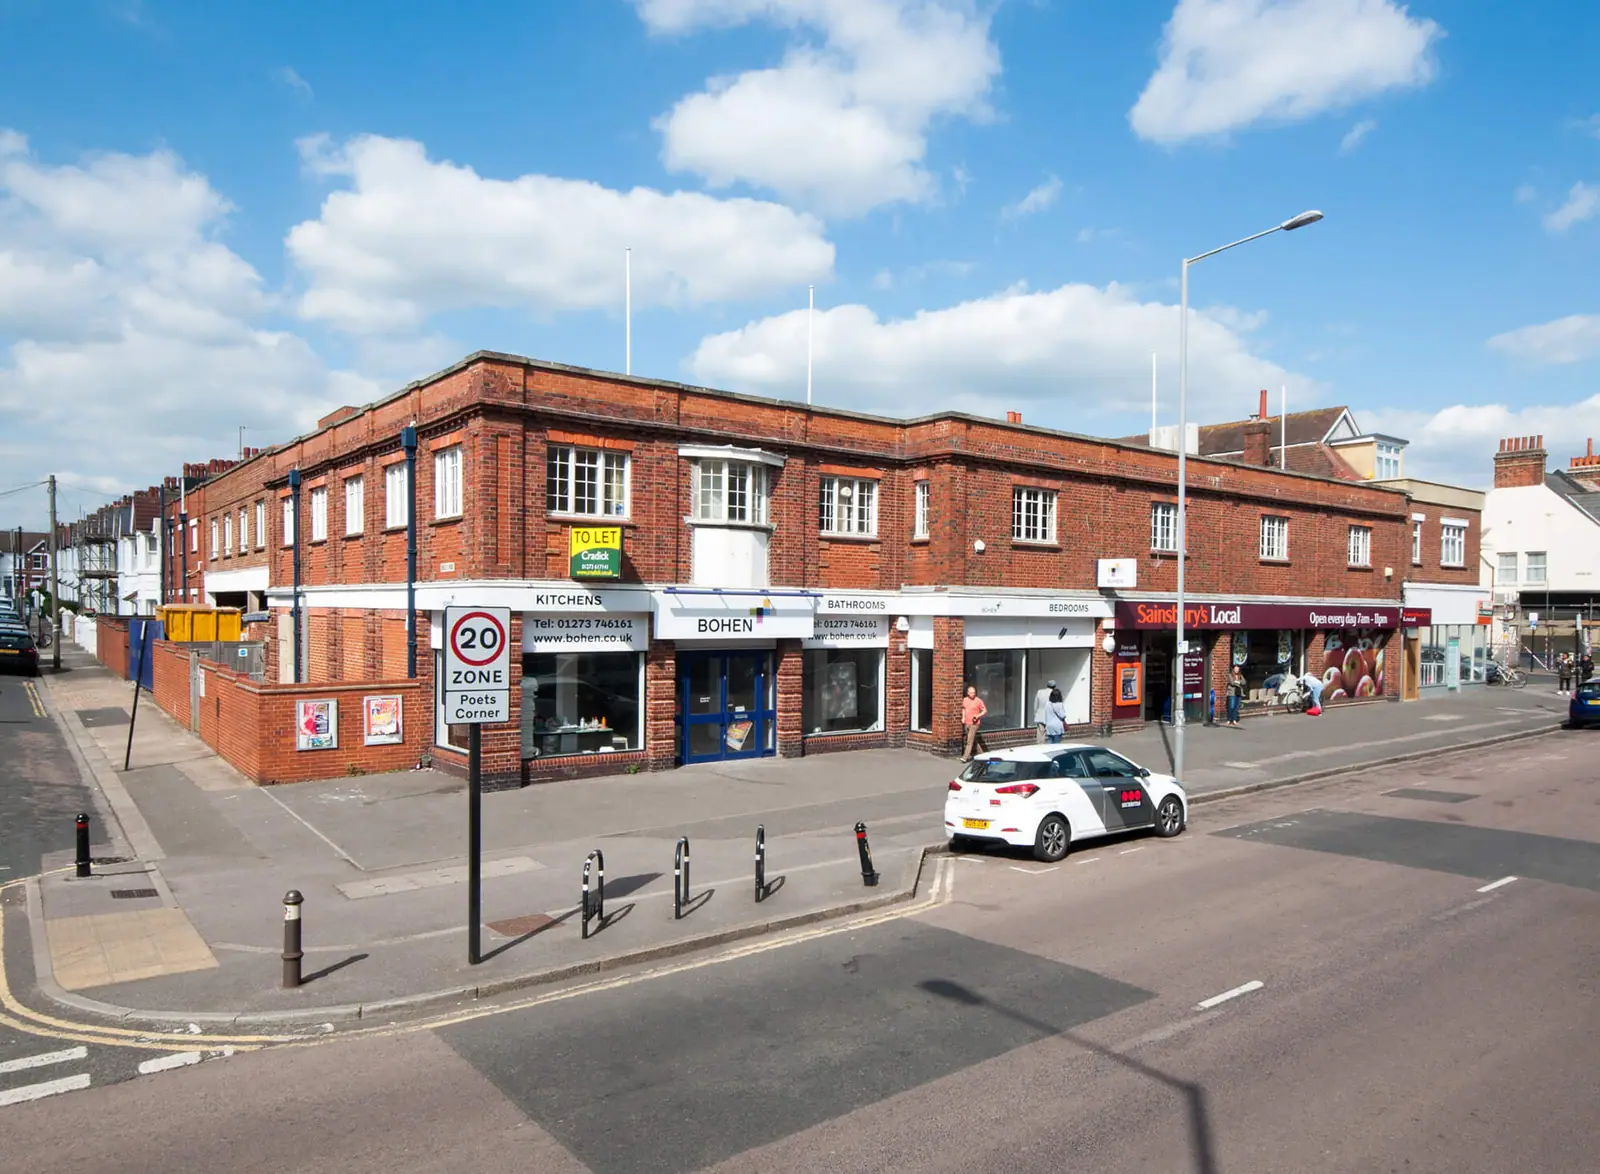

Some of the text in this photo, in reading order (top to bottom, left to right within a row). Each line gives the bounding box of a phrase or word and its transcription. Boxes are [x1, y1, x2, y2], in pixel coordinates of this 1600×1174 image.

[574, 531, 617, 543] TO LET
[581, 551, 609, 560] Cradick
[536, 595, 602, 606] KITCHENS
[828, 600, 886, 610] BATHROOMS
[1049, 603, 1089, 613] BEDROOMS
[1210, 606, 1241, 624] Local
[1309, 612, 1327, 627] Open
[1327, 616, 1345, 629] every
[1345, 613, 1357, 627] day
[1357, 613, 1370, 624] 7am
[533, 619, 633, 629] Tel: 01273 746161
[698, 619, 752, 632] BOHEN
[823, 620, 848, 629] 01273
[850, 620, 877, 629] 746161
[460, 627, 498, 649] 20
[533, 633, 633, 643] www.bohen.co.uk
[452, 670, 503, 684] ZONE
[460, 694, 497, 705] Poets
[455, 708, 500, 719] Corner
